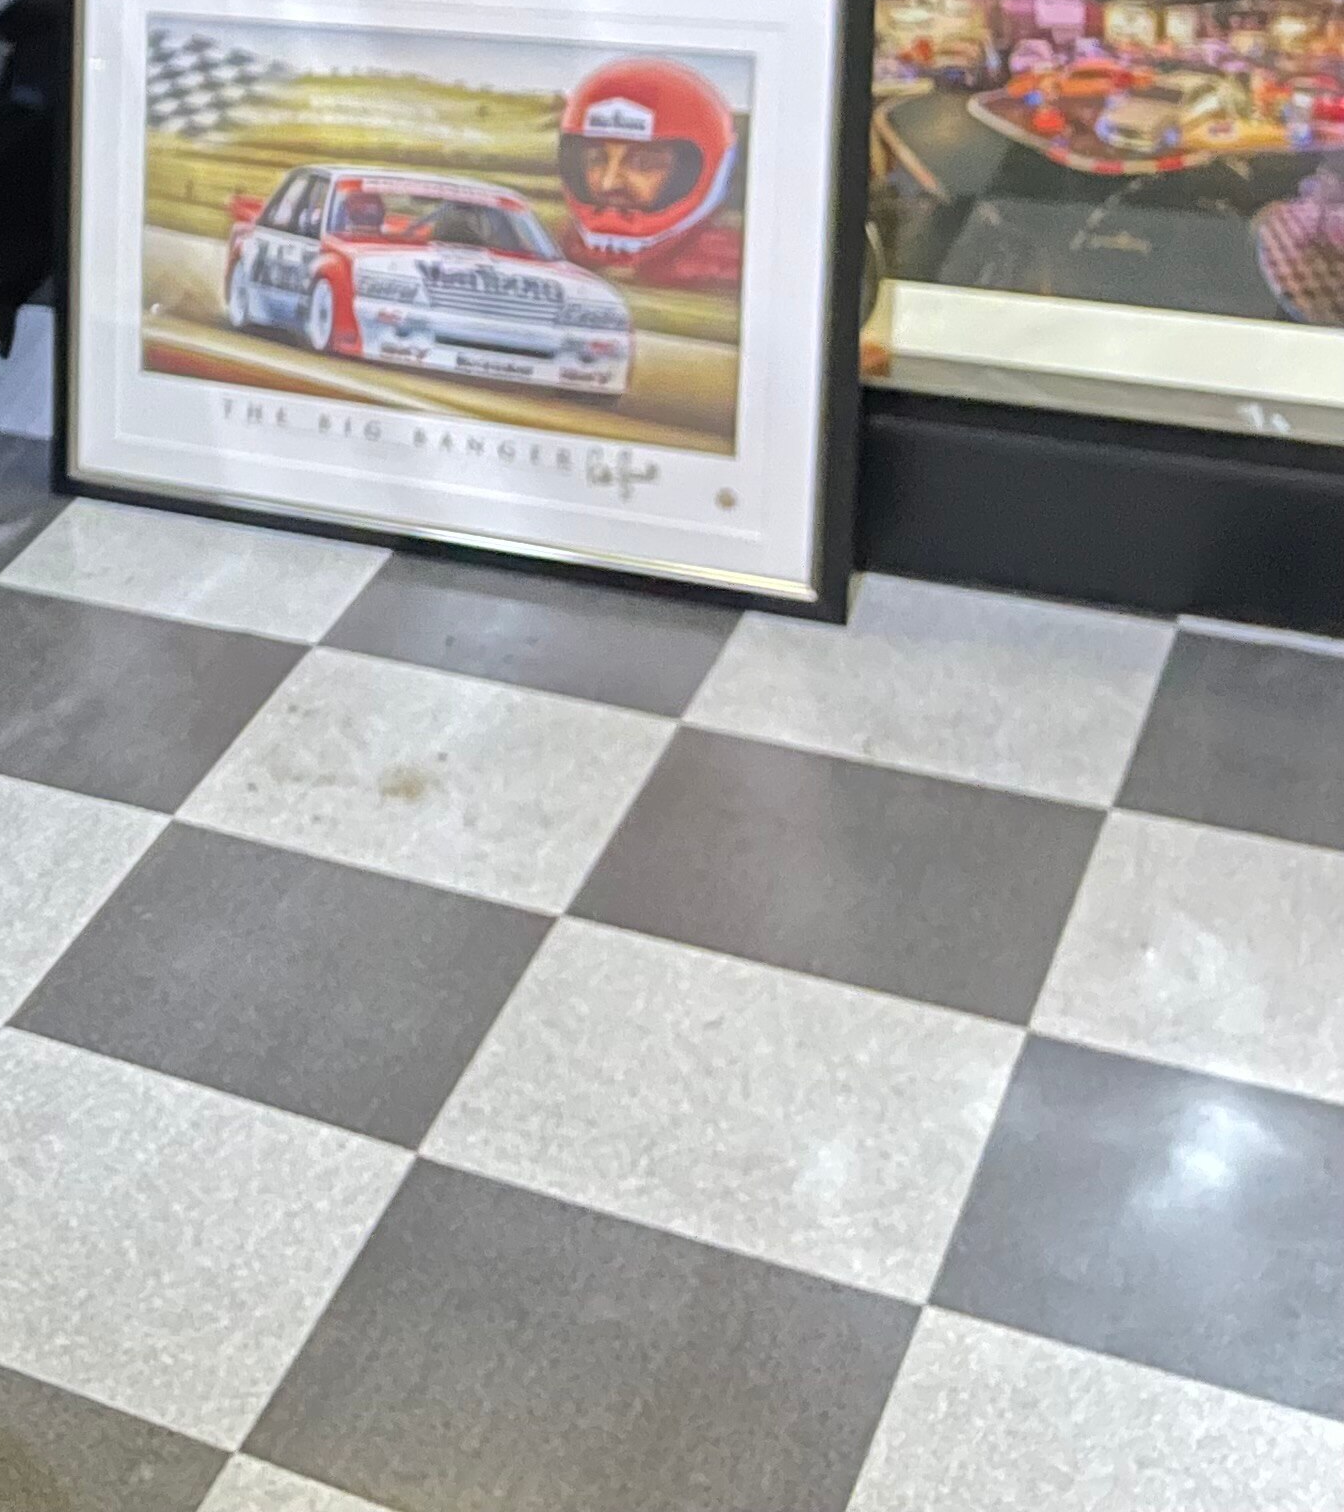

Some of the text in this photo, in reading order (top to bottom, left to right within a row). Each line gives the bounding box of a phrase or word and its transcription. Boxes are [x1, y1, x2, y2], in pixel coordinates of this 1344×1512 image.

[220, 399, 290, 428] THE
[317, 413, 383, 442] BIG
[413, 427, 573, 472] BANGER
